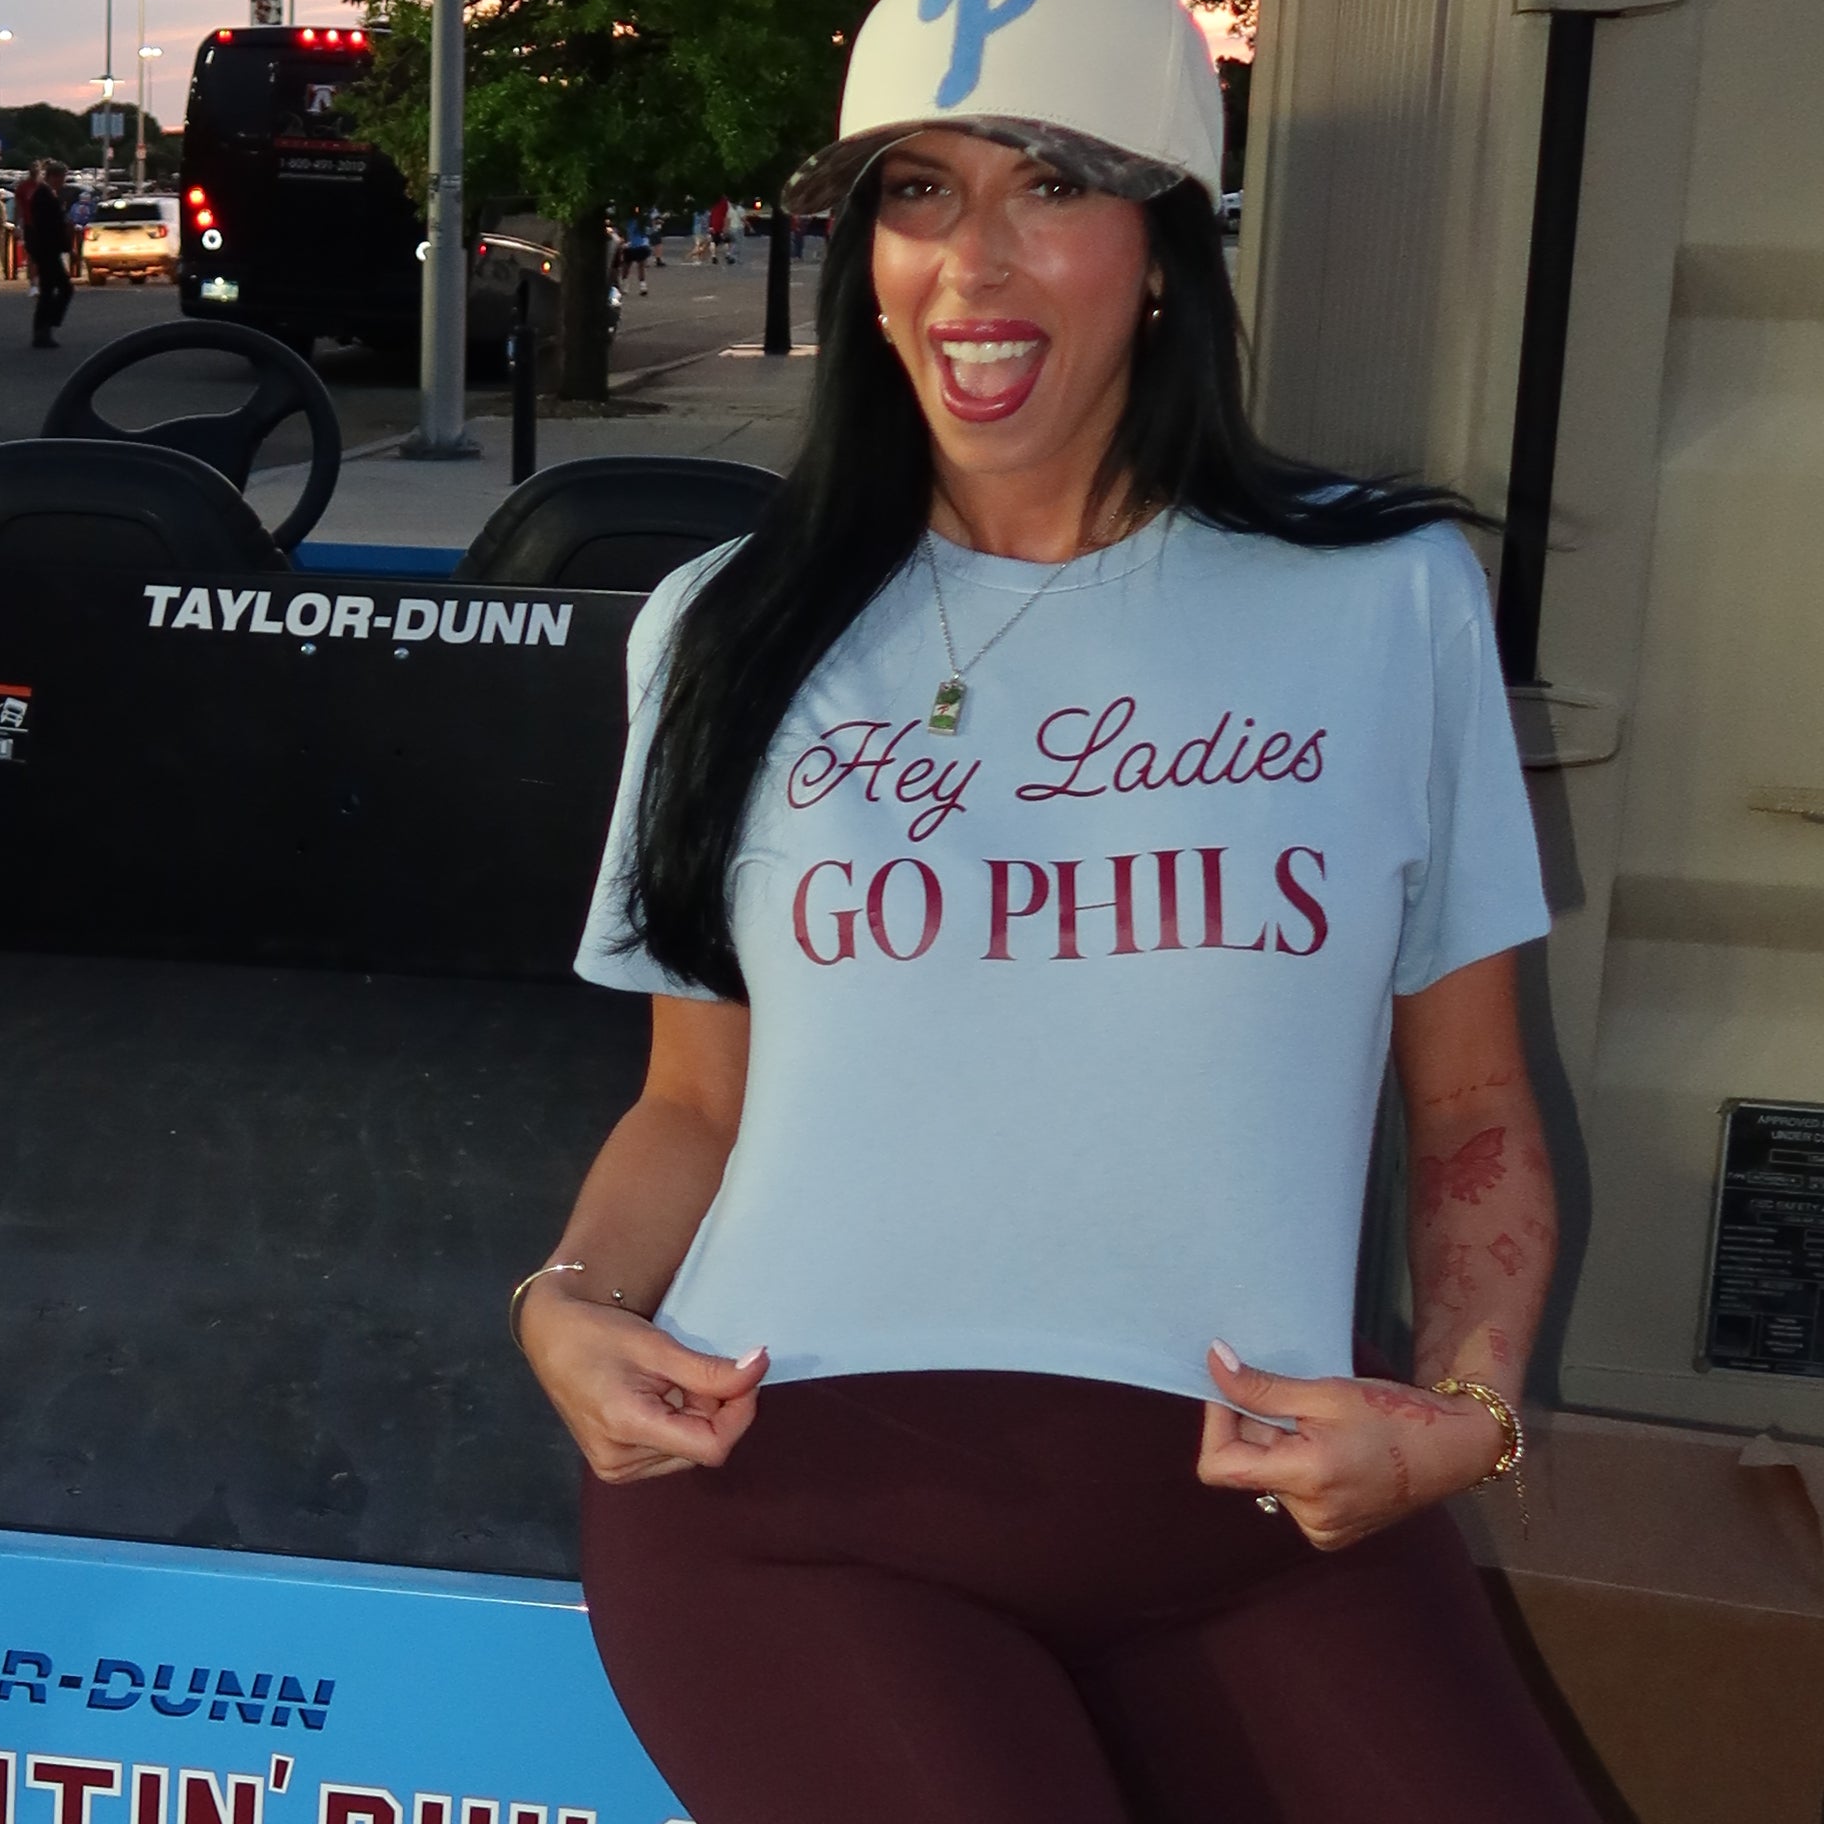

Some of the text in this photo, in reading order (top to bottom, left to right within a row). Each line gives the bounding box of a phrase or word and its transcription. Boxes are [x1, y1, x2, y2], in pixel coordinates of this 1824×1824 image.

[143, 584, 573, 647] TAYLOR-DUNN
[787, 696, 1328, 843] Hey Ladies
[792, 846, 1329, 966] GO PHILS
